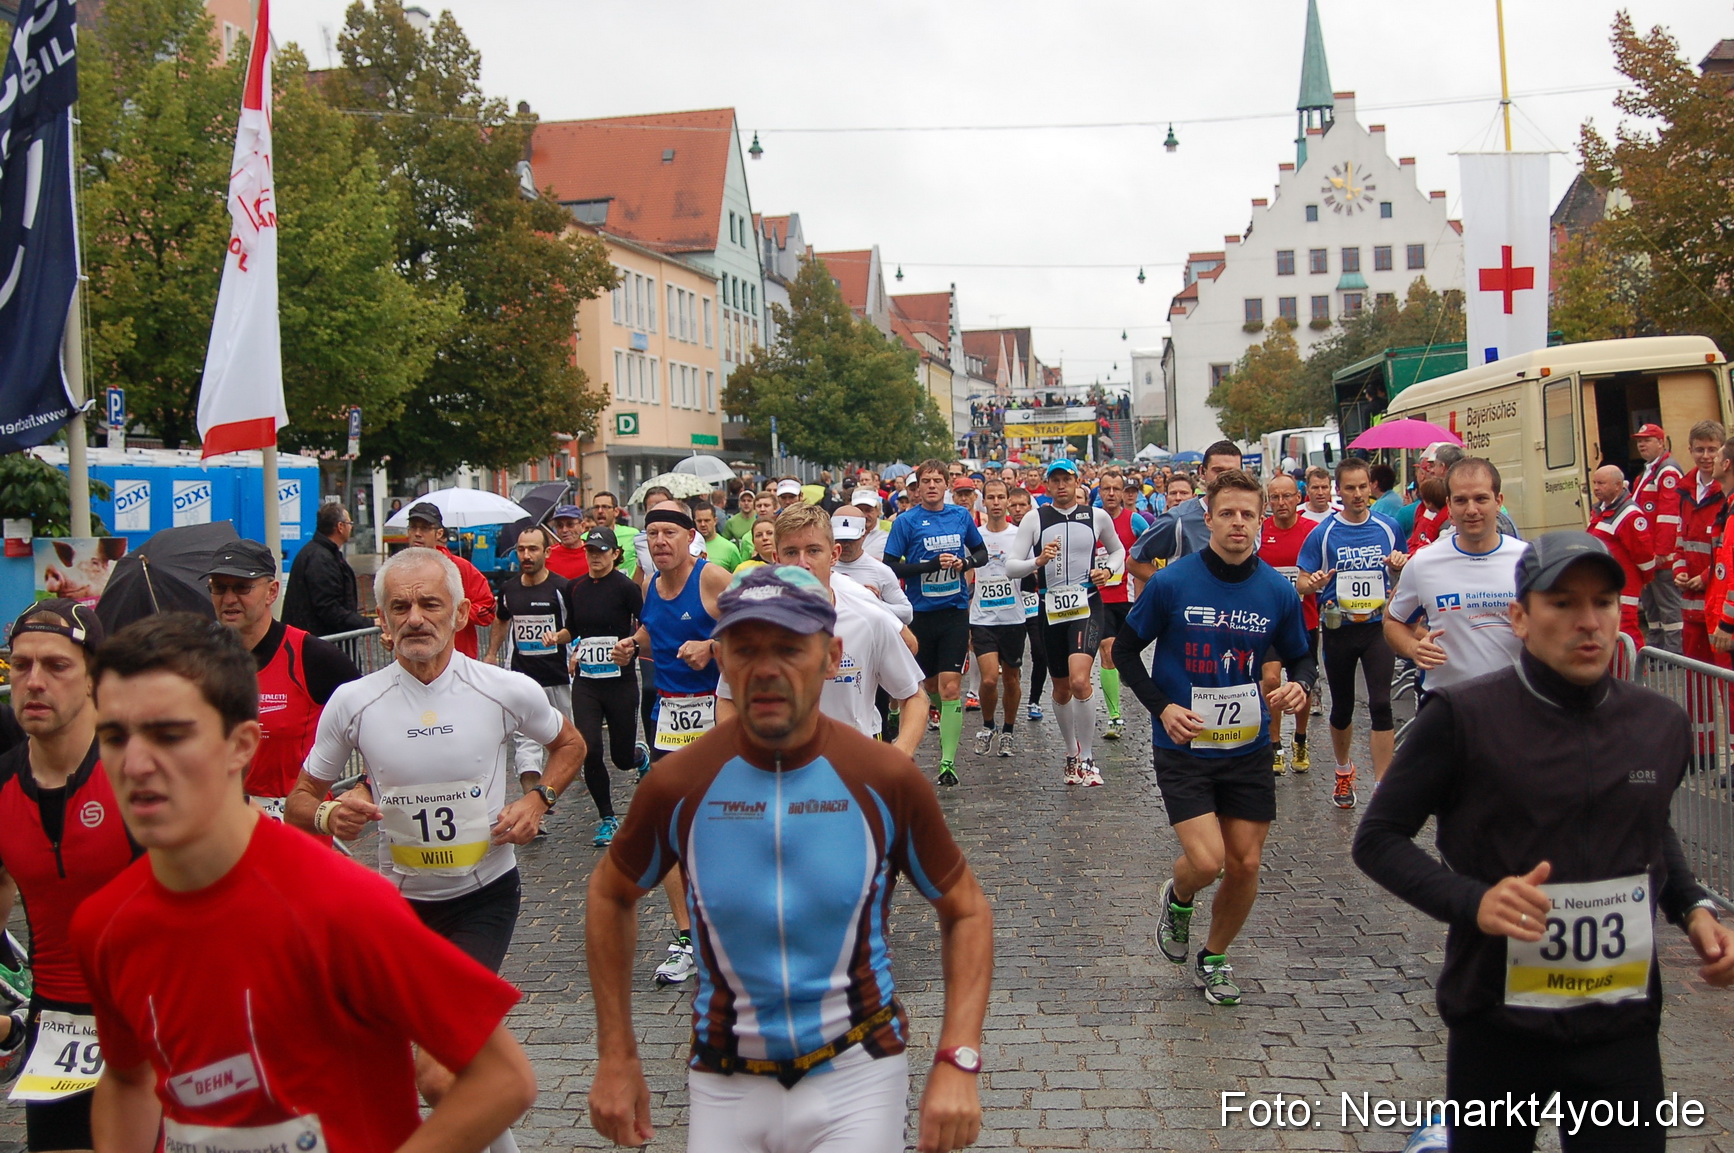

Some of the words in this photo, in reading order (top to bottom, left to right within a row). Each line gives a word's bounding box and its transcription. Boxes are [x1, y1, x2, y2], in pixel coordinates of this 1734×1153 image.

[110, 393, 121, 421] P
[1466, 400, 1517, 428] Bayerisches
[619, 415, 635, 433] D
[1034, 426, 1065, 435] START
[1545, 480, 1574, 494] Bayerisches
[923, 533, 961, 549] HUBER
[1336, 545, 1382, 560] Fitness
[1336, 555, 1386, 572] CORNER
[981, 583, 1012, 598] 2536
[1352, 581, 1370, 597] 90
[1054, 593, 1079, 610] 502
[1350, 600, 1372, 609] Jürgen
[1230, 609, 1271, 626] HiRo
[1229, 622, 1248, 631] Run
[1249, 624, 1267, 633] 21.1
[579, 647, 614, 663] 2105
[1185, 642, 1198, 657] BE
[1203, 642, 1211, 658] A
[1185, 658, 1218, 675] HERO!
[1193, 693, 1217, 701] PARTL
[1219, 691, 1248, 701] Neumarkt
[670, 709, 704, 731] 362
[1214, 701, 1241, 727] 72
[1212, 730, 1241, 742] Daniel
[1628, 770, 1656, 780] GORE
[381, 795, 414, 806] PARTL
[415, 791, 467, 804] Neumarkt
[411, 806, 457, 843] 13
[421, 850, 454, 865] Willi
[1564, 892, 1627, 910] Neumarkt
[1539, 912, 1626, 962] 303
[1546, 973, 1614, 992] Marcus
[42, 1021, 80, 1036] PARTL
[54, 1040, 103, 1075] 49
[194, 1069, 234, 1096] DEHN
